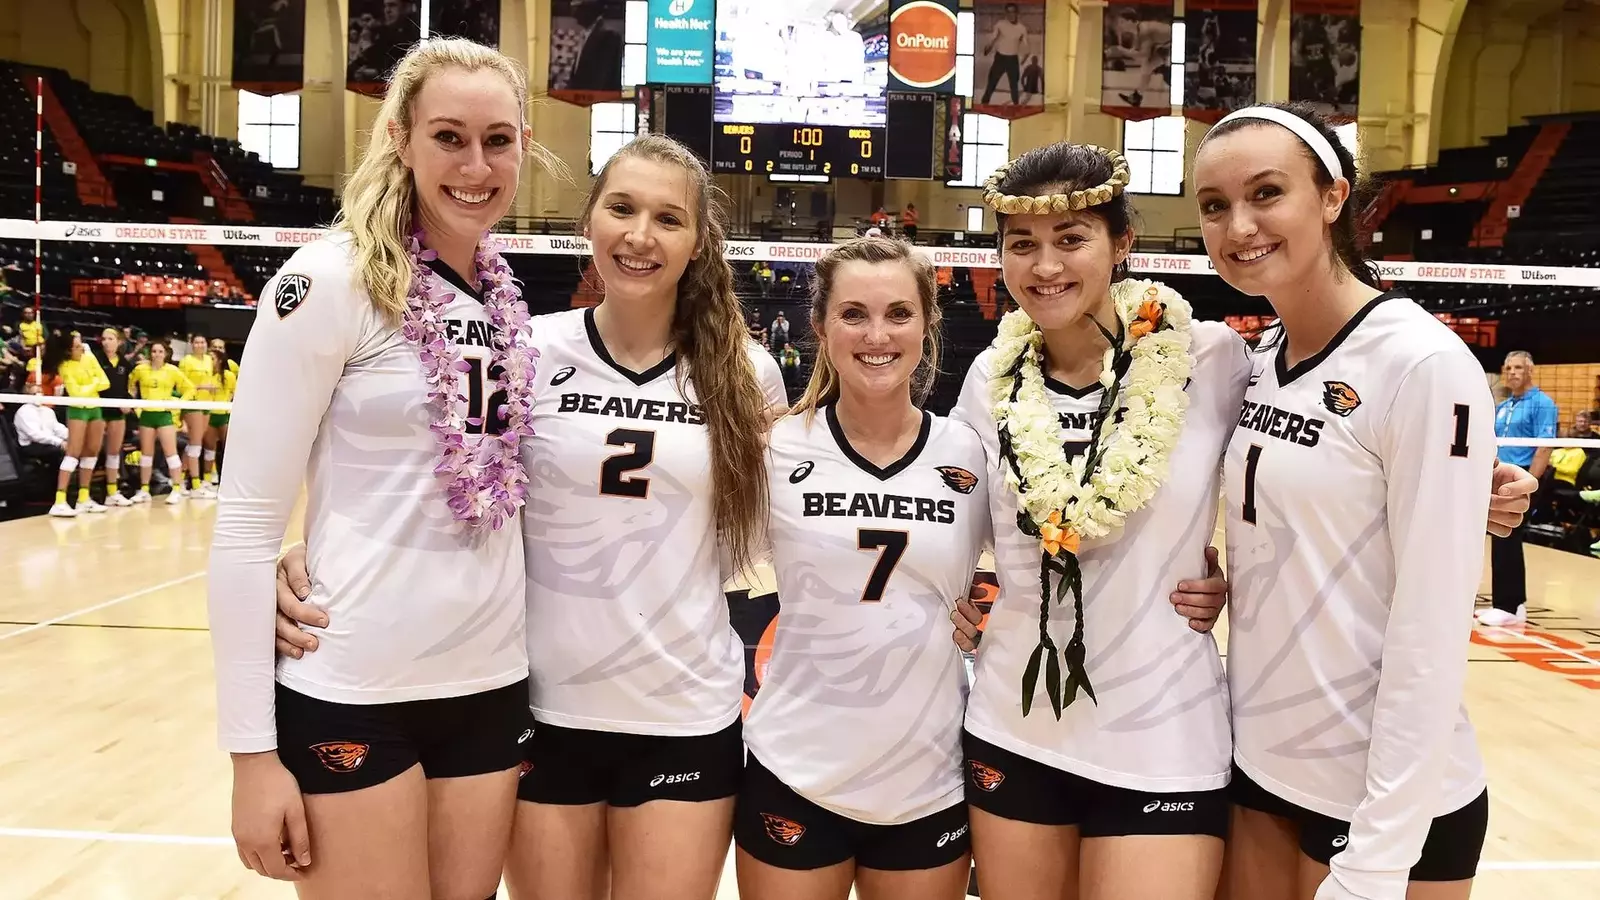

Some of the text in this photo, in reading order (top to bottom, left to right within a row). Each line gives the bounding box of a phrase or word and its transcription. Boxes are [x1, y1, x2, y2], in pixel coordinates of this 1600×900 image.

[655, 17, 688, 29] Health
[896, 33, 949, 49] OnPoint
[656, 48, 669, 56] We
[657, 57, 682, 66] Health
[793, 128, 822, 146] 1:00
[740, 136, 752, 154] 0
[861, 140, 872, 158] 0
[779, 150, 803, 158] PERIOD
[810, 149, 815, 161] 1
[745, 160, 753, 171] 0
[766, 160, 774, 172] 2
[823, 162, 832, 173] 2
[851, 163, 859, 175] 0
[77, 228, 101, 236] asics
[115, 227, 207, 240] OREGON STATE
[223, 230, 260, 240] Wilson
[550, 239, 589, 250] Wilson
[729, 246, 755, 255] asics
[769, 246, 822, 258] OREGON
[934, 252, 987, 264] OREGON
[1153, 258, 1191, 270] STATE
[1418, 267, 1506, 279] OREGON STATE
[1521, 270, 1556, 281] Wilson
[277, 275, 310, 303] PAC
[277, 293, 293, 310] 12
[558, 393, 707, 426] BEAVERS
[1449, 402, 1470, 458] 1
[599, 427, 656, 499] 2
[1242, 442, 1264, 527] 1
[803, 492, 955, 524] BEAVERS
[857, 527, 909, 603] 7
[666, 771, 701, 784] asics
[1161, 802, 1195, 812] asics
[950, 821, 968, 841] asic
